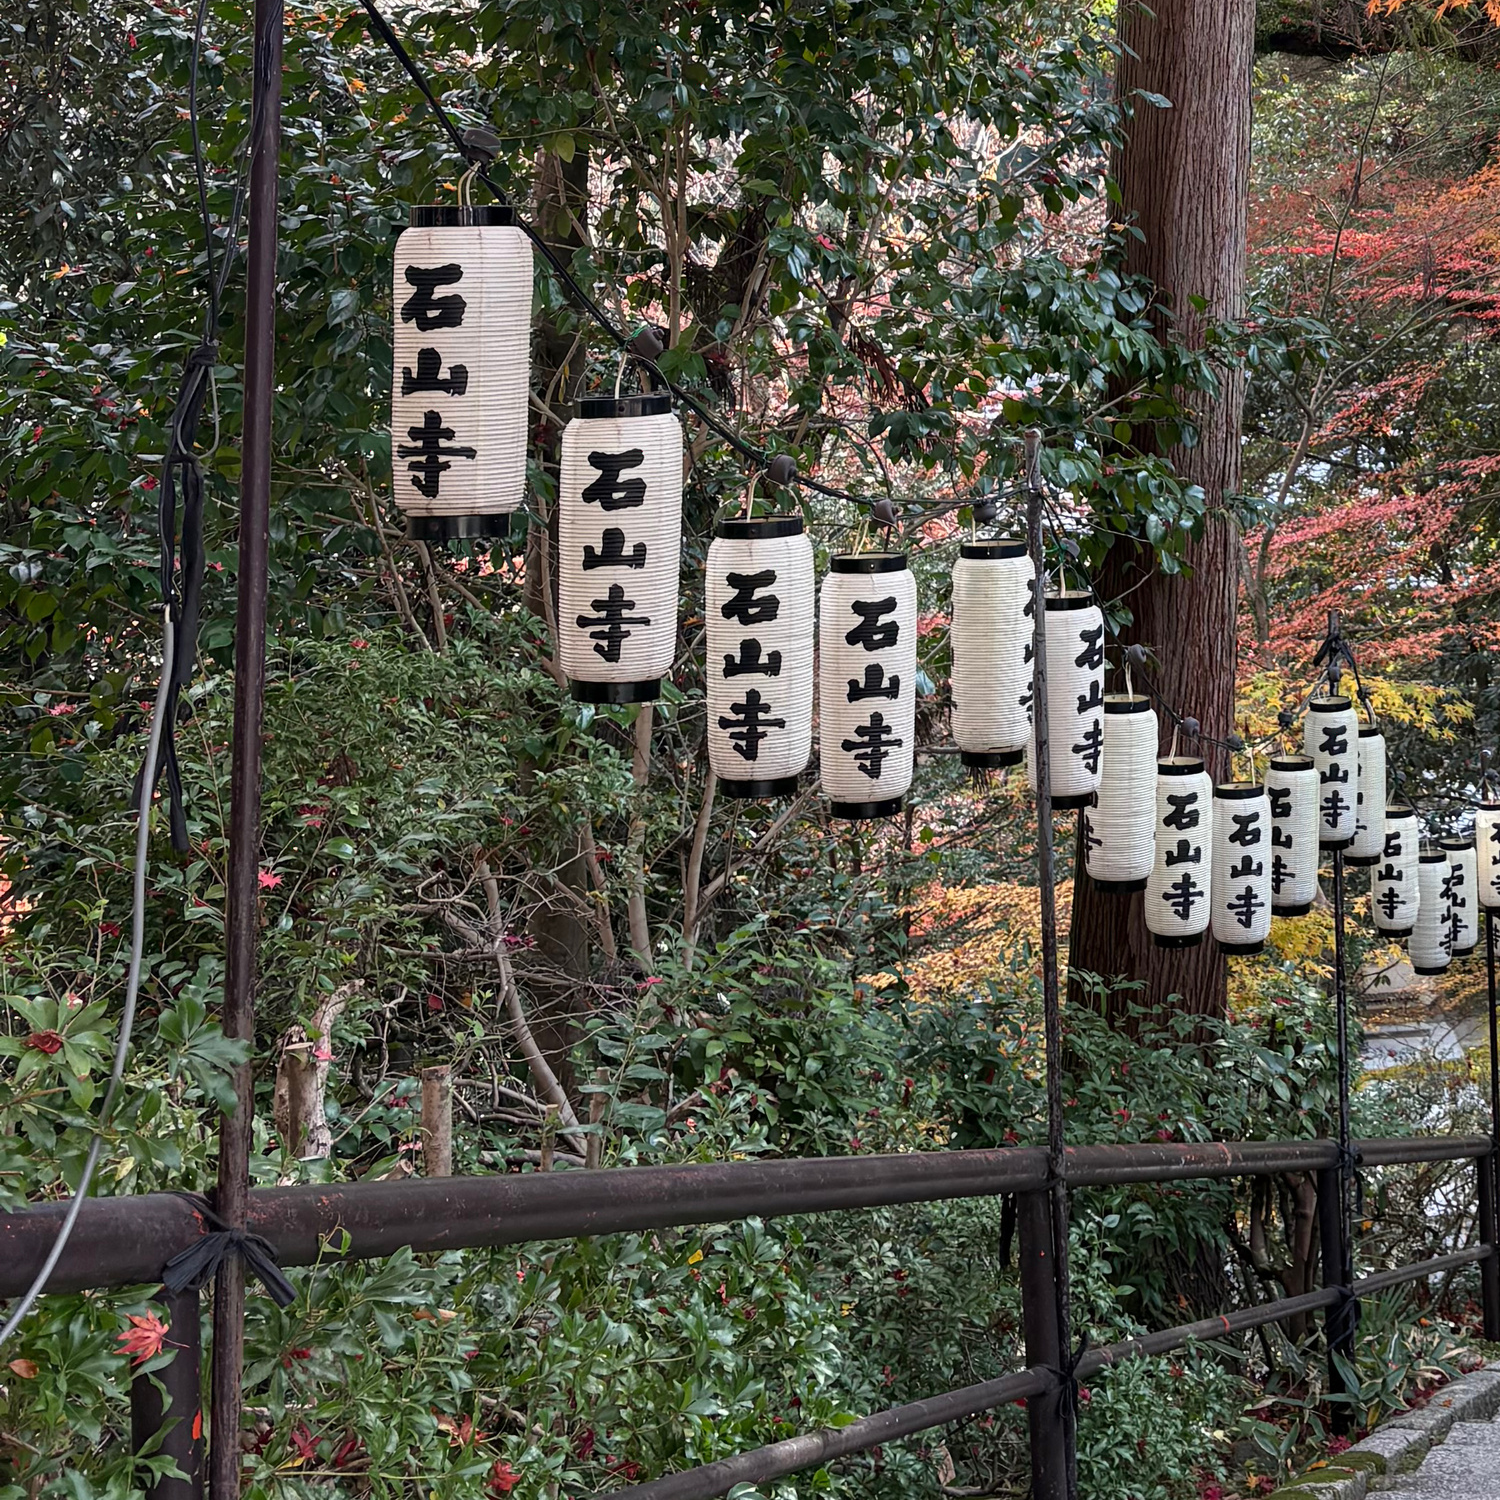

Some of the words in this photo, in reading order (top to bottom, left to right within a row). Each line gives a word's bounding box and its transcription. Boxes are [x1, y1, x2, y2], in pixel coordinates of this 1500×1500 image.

[398, 263, 476, 498] 石山寺
[576, 449, 650, 663] 石山寺
[718, 570, 786, 761] 石山寺
[841, 597, 902, 779] 石山寺
[1319, 725, 1350, 828] 石山寺
[1162, 792, 1204, 920] 石山寺
[1227, 812, 1266, 928] 石山寺
[1376, 831, 1406, 919] 石山寺
